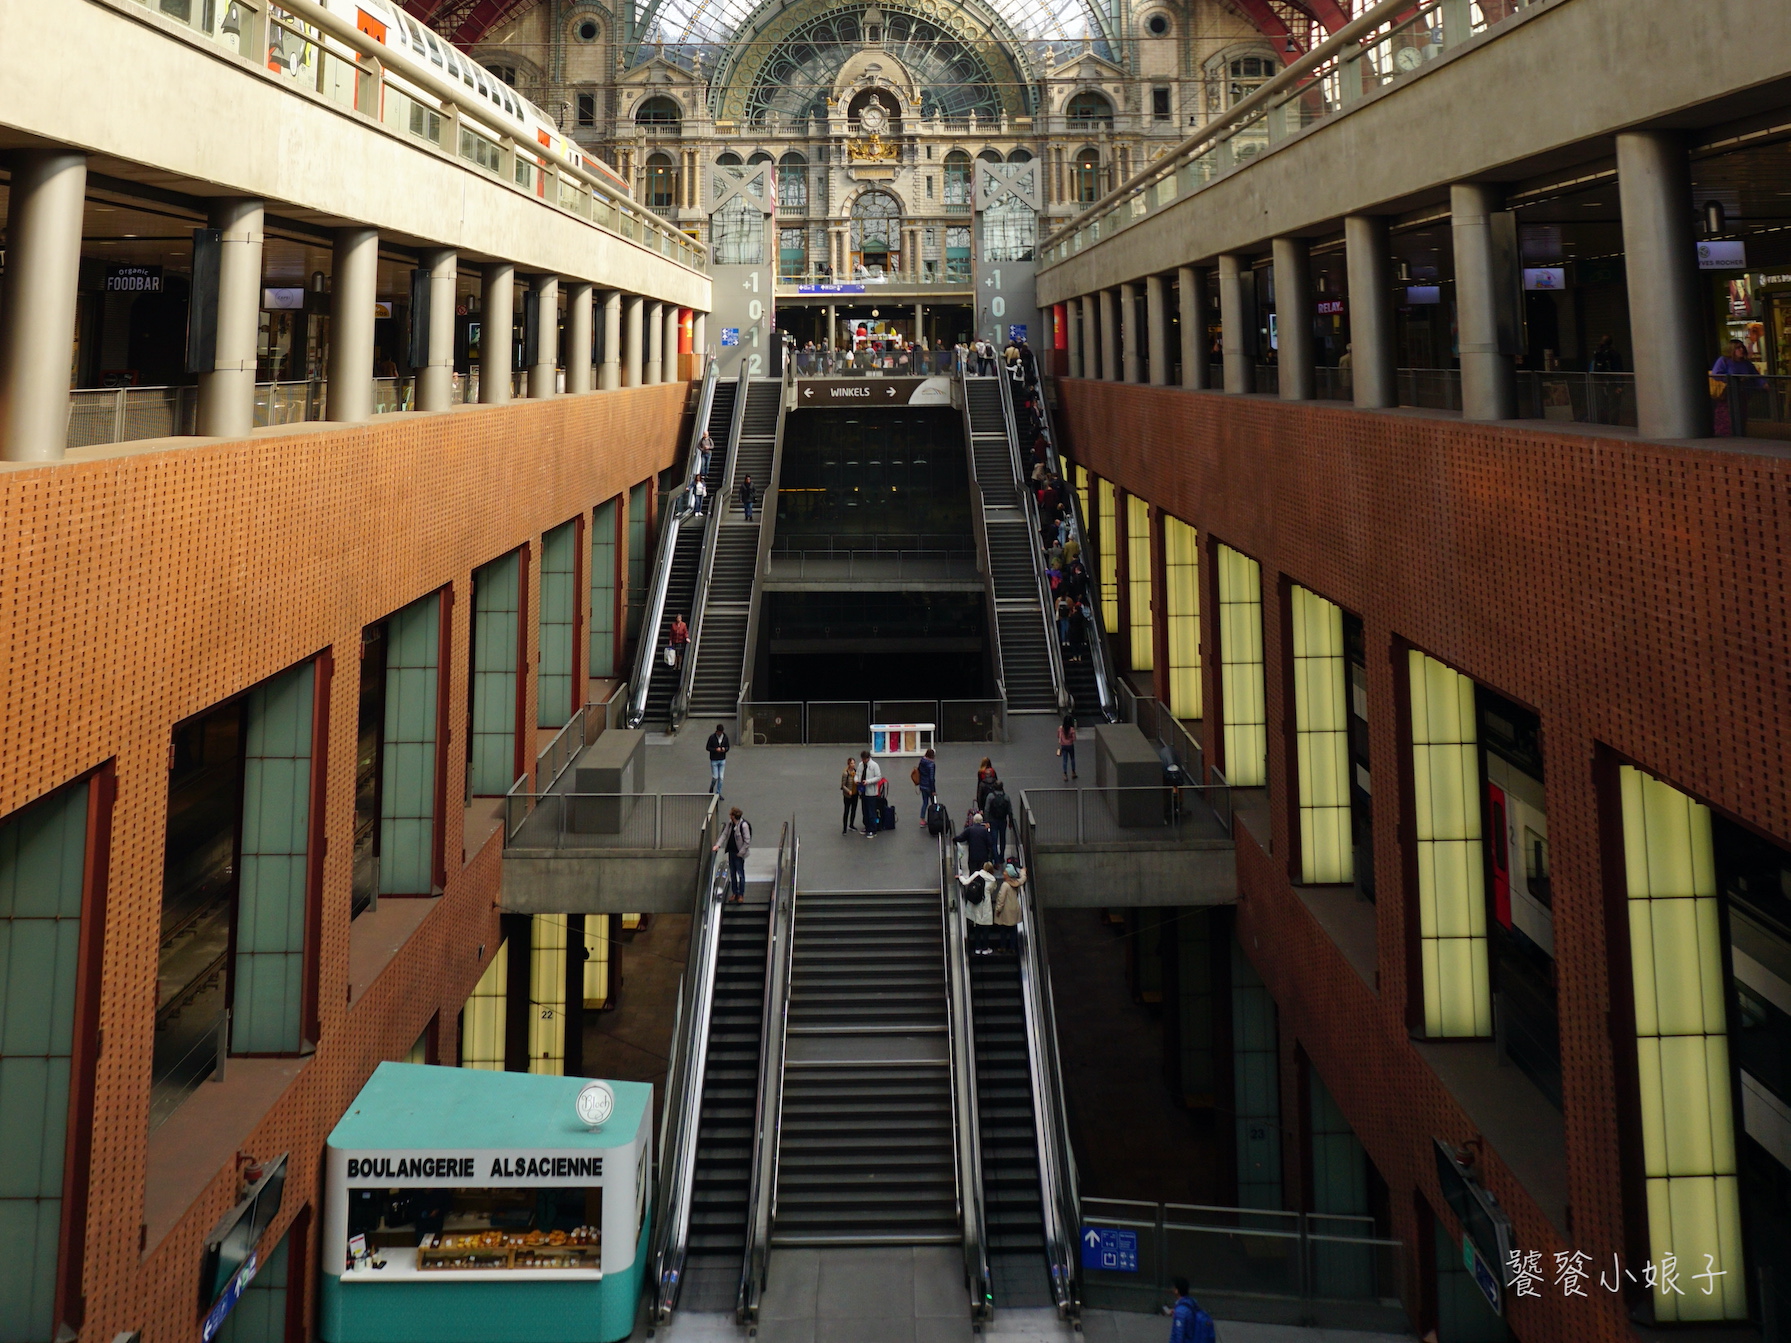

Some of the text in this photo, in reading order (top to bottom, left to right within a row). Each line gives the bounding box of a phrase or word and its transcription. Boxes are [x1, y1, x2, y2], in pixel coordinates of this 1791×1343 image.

[107, 276, 160, 291] FOODBAR
[748, 299, 762, 320] 0
[992, 296, 1006, 317] 0
[1317, 301, 1341, 314] RELAY
[830, 387, 870, 398] WINKELS
[541, 1010, 553, 1020] 22
[1250, 1128, 1264, 1140] 23
[347, 1157, 603, 1178] BOULANGERIE ALSACIENNE
